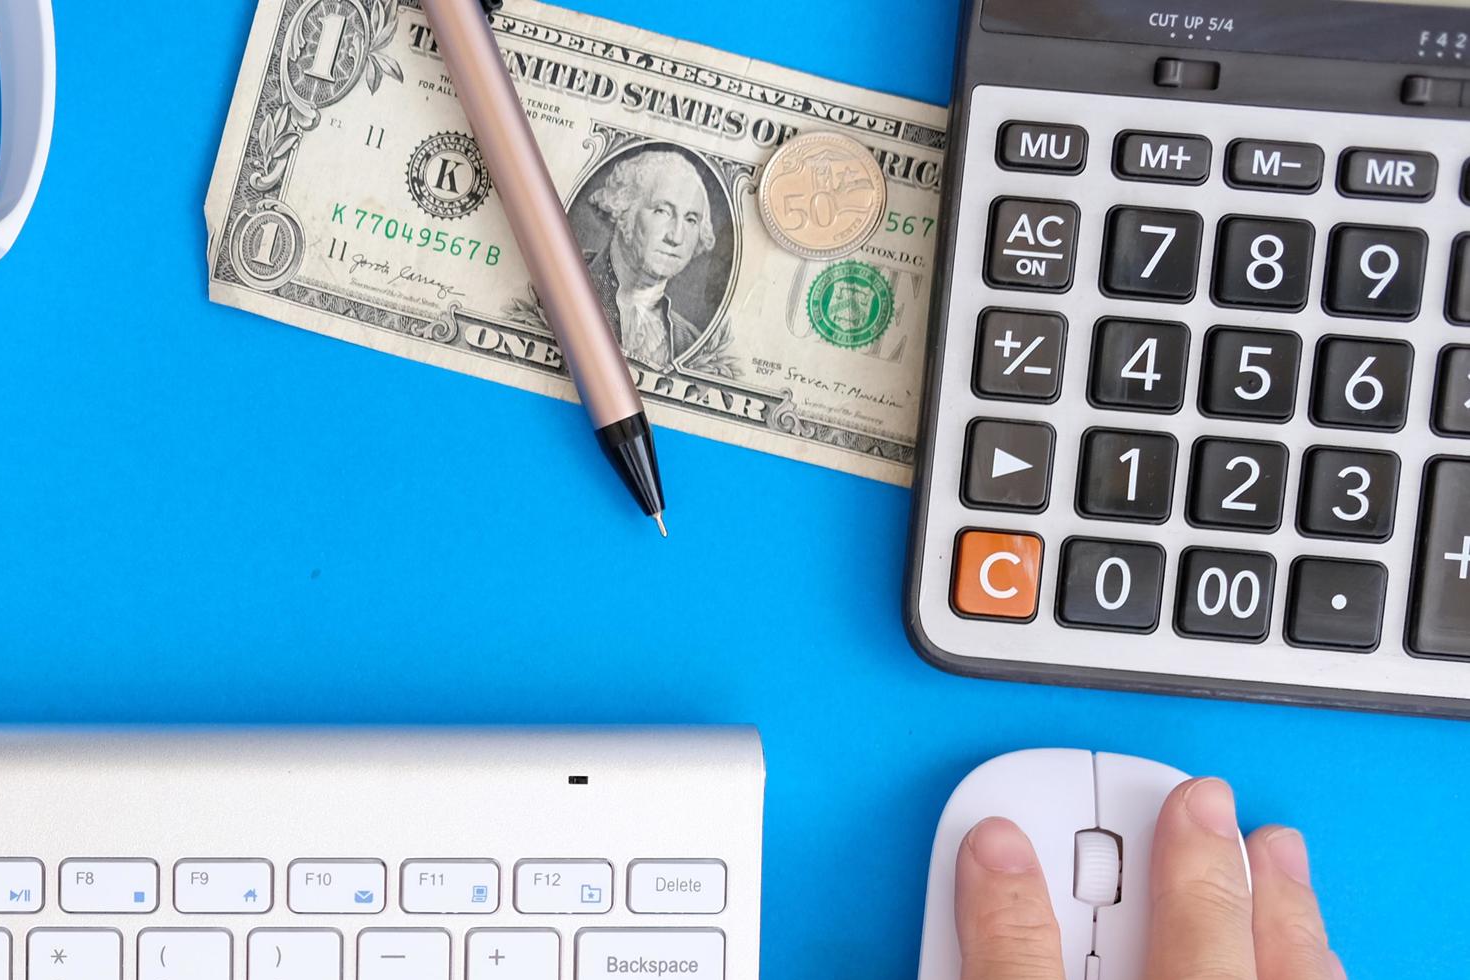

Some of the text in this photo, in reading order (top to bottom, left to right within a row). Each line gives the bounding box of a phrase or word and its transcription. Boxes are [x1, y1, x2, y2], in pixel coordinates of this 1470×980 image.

[1149, 13, 1233, 31] CUT UP 5/4
[1420, 31, 1466, 47] F 4 2
[304, 13, 346, 83] 1
[495, 15, 901, 136] FEDERAL RESERVE NOTE
[418, 80, 435, 92] FOR
[437, 86, 452, 98] ALL
[540, 112, 575, 129] PRIVATE
[502, 48, 617, 101] NITED
[622, 81, 747, 140] STATES
[526, 98, 561, 114] TENDER
[1020, 132, 1070, 159] MU
[1140, 143, 1191, 169] M+
[435, 157, 465, 194] K
[1366, 159, 1415, 186] MR
[783, 190, 838, 232] 50
[1007, 214, 1064, 247] AC
[1016, 258, 1045, 276] ON
[1141, 225, 1176, 278] 7
[1246, 234, 1284, 289] 8
[1360, 244, 1399, 298] 9
[465, 324, 562, 369] ONE
[630, 367, 767, 423] LLAR
[752, 357, 782, 371] SERIES
[1121, 338, 1161, 390] 4
[1234, 346, 1272, 400] 5
[1345, 357, 1383, 410] 6
[1119, 448, 1140, 501] 1
[1222, 456, 1260, 511] 2
[1332, 466, 1370, 521] 3
[980, 552, 1021, 598] C
[1096, 557, 1131, 610] 0
[1197, 567, 1260, 618] 00
[77, 872, 94, 885] F8
[191, 872, 208, 885] F9
[306, 873, 331, 886] F10
[420, 873, 443, 885] F11
[534, 873, 560, 886] F12
[656, 877, 701, 892] Delete
[159, 945, 166, 968] (
[275, 945, 282, 968] )
[489, 949, 505, 965] +
[607, 956, 698, 976] Backspace
